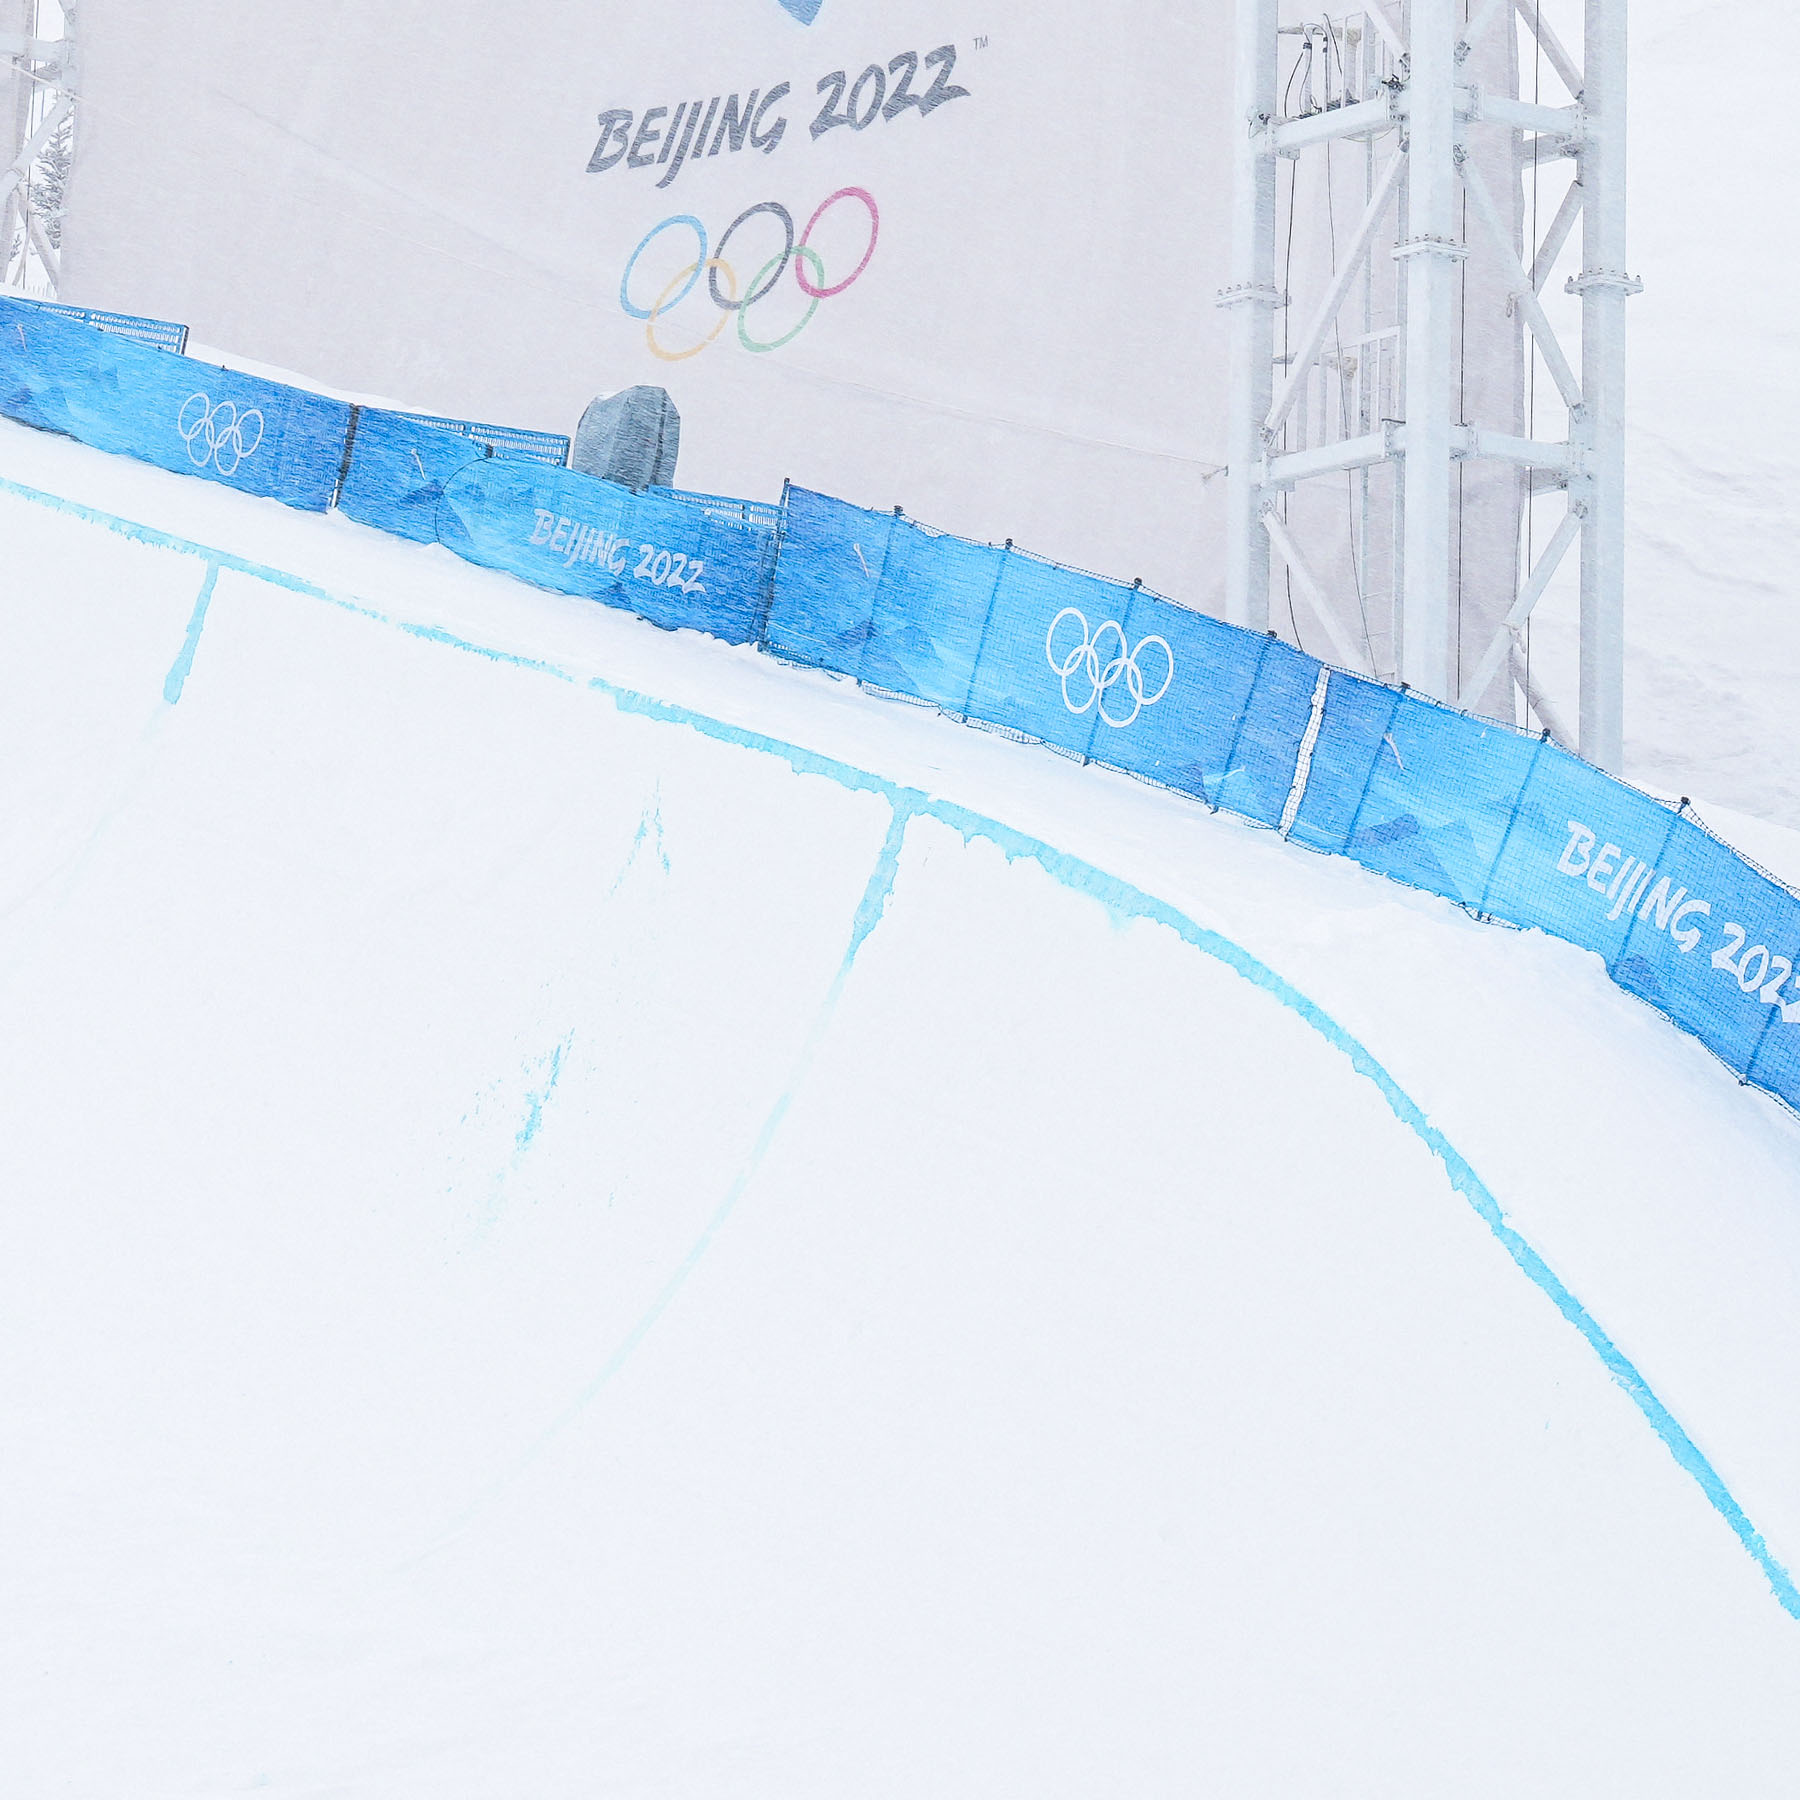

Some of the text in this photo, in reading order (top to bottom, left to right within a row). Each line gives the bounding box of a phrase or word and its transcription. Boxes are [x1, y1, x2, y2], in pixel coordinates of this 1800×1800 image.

[585, 81, 791, 189] BEIJING
[809, 44, 972, 142] 2022
[530, 508, 706, 595] BEIJING 2022
[1555, 819, 1711, 953] BEIJING
